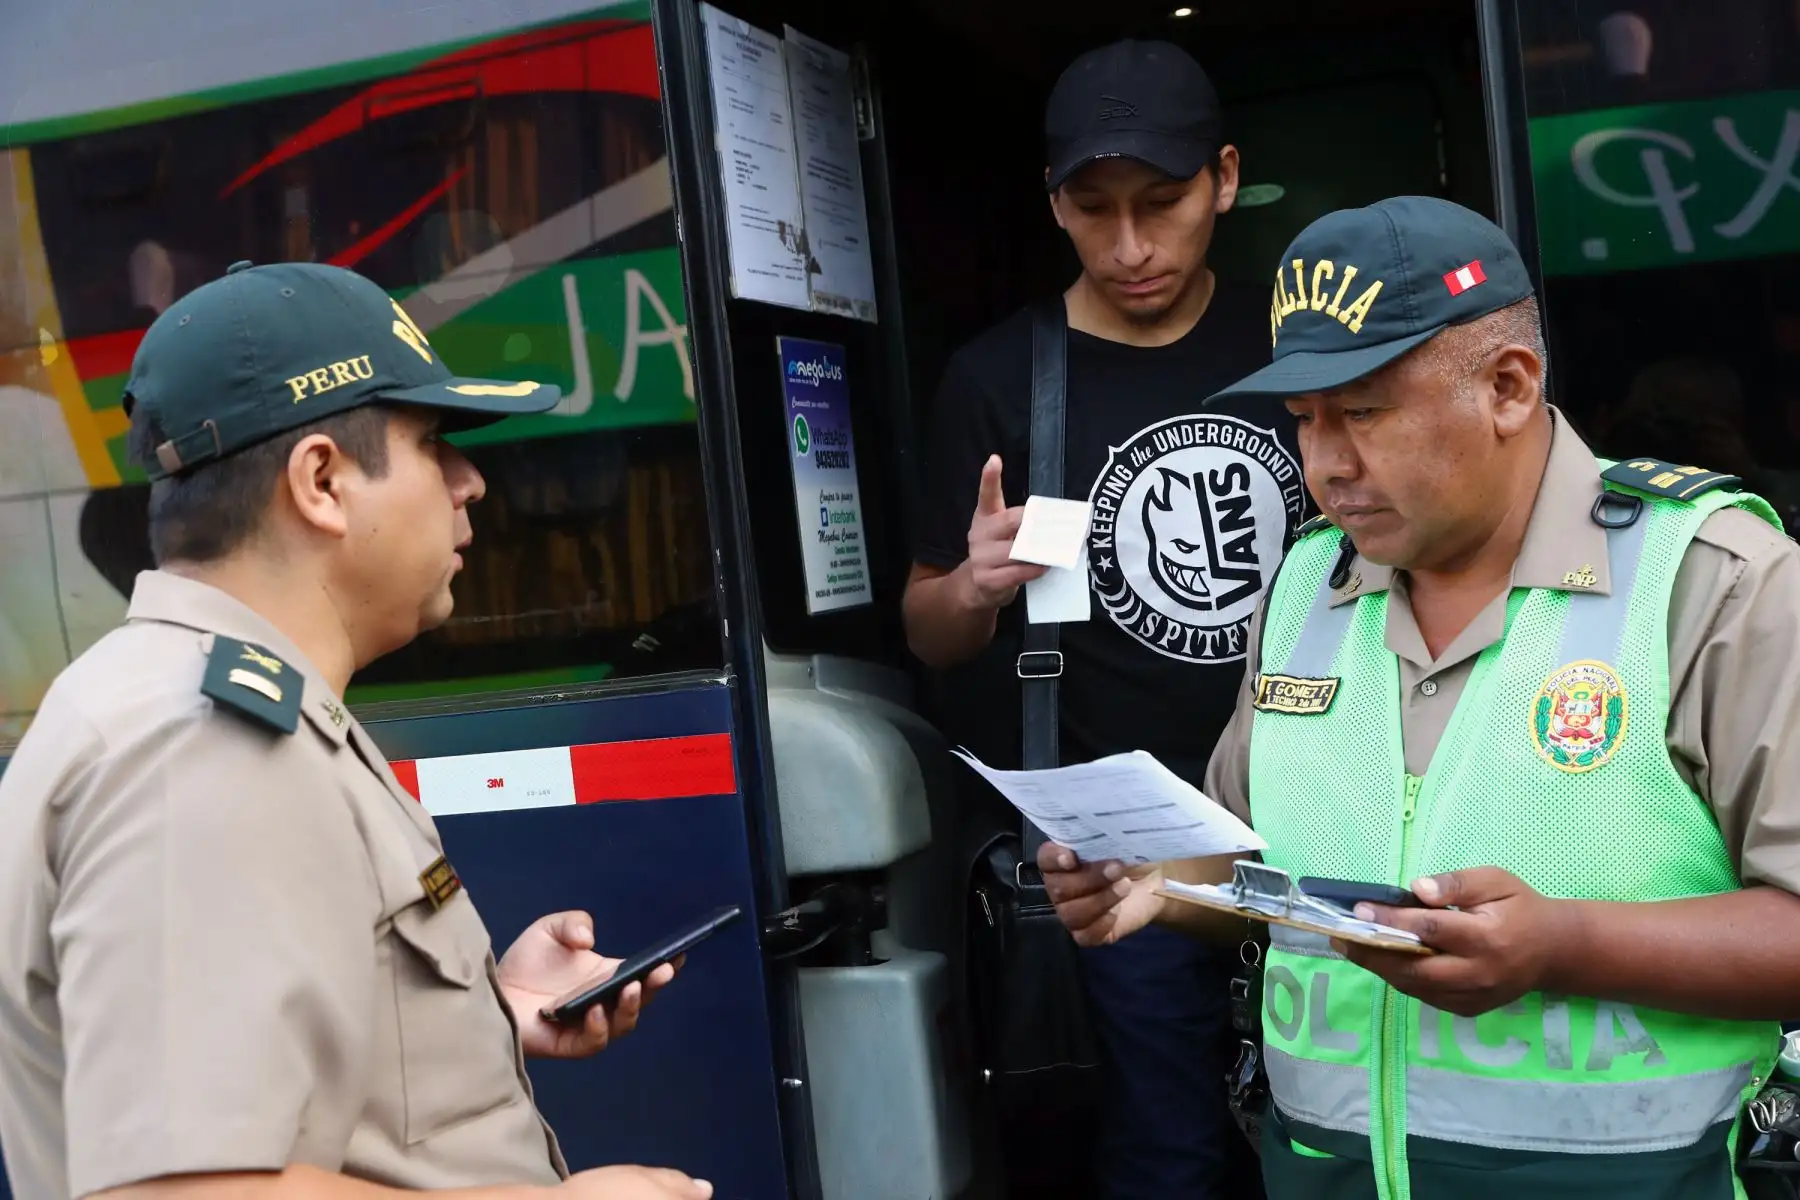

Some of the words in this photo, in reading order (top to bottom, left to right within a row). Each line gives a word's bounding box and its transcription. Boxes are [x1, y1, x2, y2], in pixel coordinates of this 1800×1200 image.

[285, 355, 375, 404] PERU
[1092, 464, 1134, 549] KEEPING
[1130, 442, 1155, 468] the
[1152, 423, 1294, 482] UNDERGROUND
[1193, 462, 1263, 611] VANS
[1138, 611, 1250, 658] SPITF
[1274, 682, 1319, 699] GOMEZ
[1546, 668, 1578, 693] POLICIA
[1582, 667, 1617, 691] NACIONAL
[486, 777, 504, 789] 3M
[1264, 965, 1667, 1071] OLICIA
